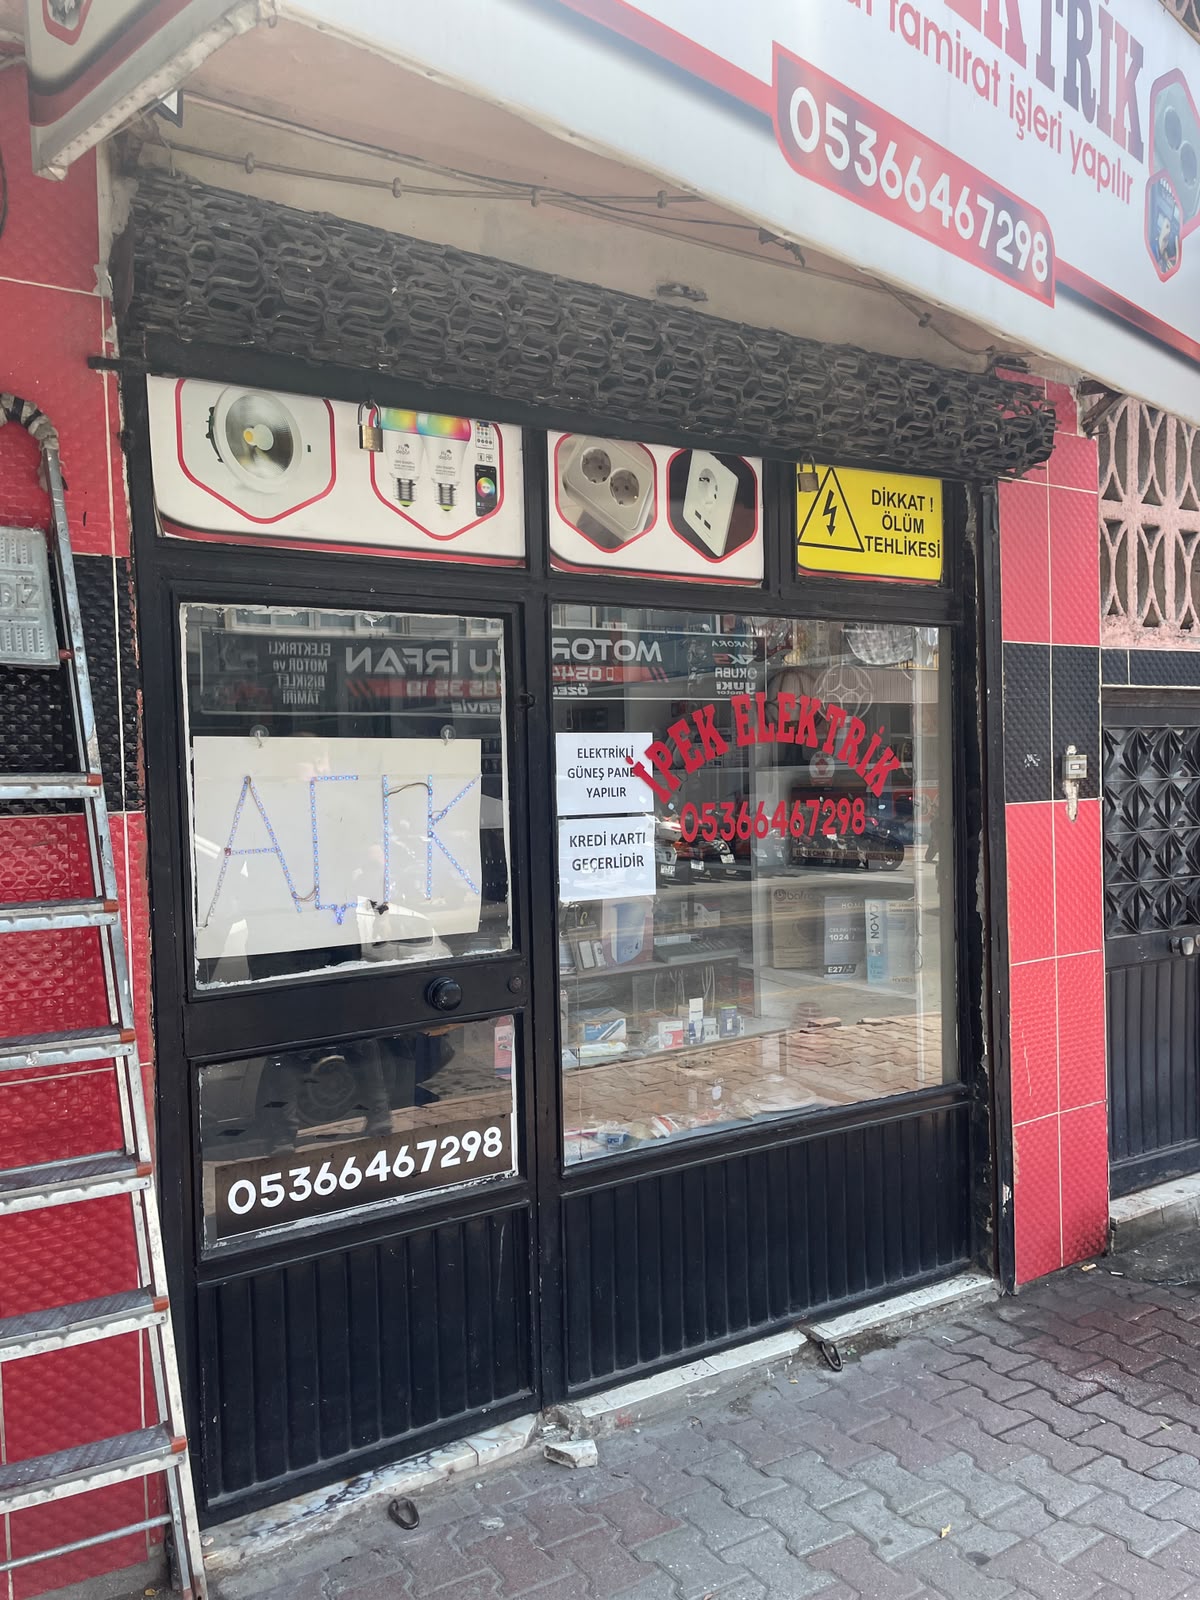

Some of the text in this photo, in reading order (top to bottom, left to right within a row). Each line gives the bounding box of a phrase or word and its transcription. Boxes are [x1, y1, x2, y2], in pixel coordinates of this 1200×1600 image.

[1009, 73, 1062, 154] işleri
[1069, 129, 1134, 204] yapılır
[789, 86, 1049, 283] 05366467298
[871, 487, 925, 511] DİKKAT
[882, 511, 924, 534] ÖLÜM
[864, 535, 941, 558] TEHLİKESİ
[577, 745, 634, 759] ELEKTRİKLİ
[625, 692, 901, 804] İPEK ELEKTRİK
[567, 766, 637, 780] GÜNEŞ PANE
[586, 787, 627, 798] YAPILIR
[680, 797, 867, 843] 05366467298
[569, 831, 646, 848] KREDİ KARTI
[572, 853, 645, 872] GEÇERLİDİR
[829, 933, 849, 941] 1024
[227, 1126, 503, 1215] 05366467298
